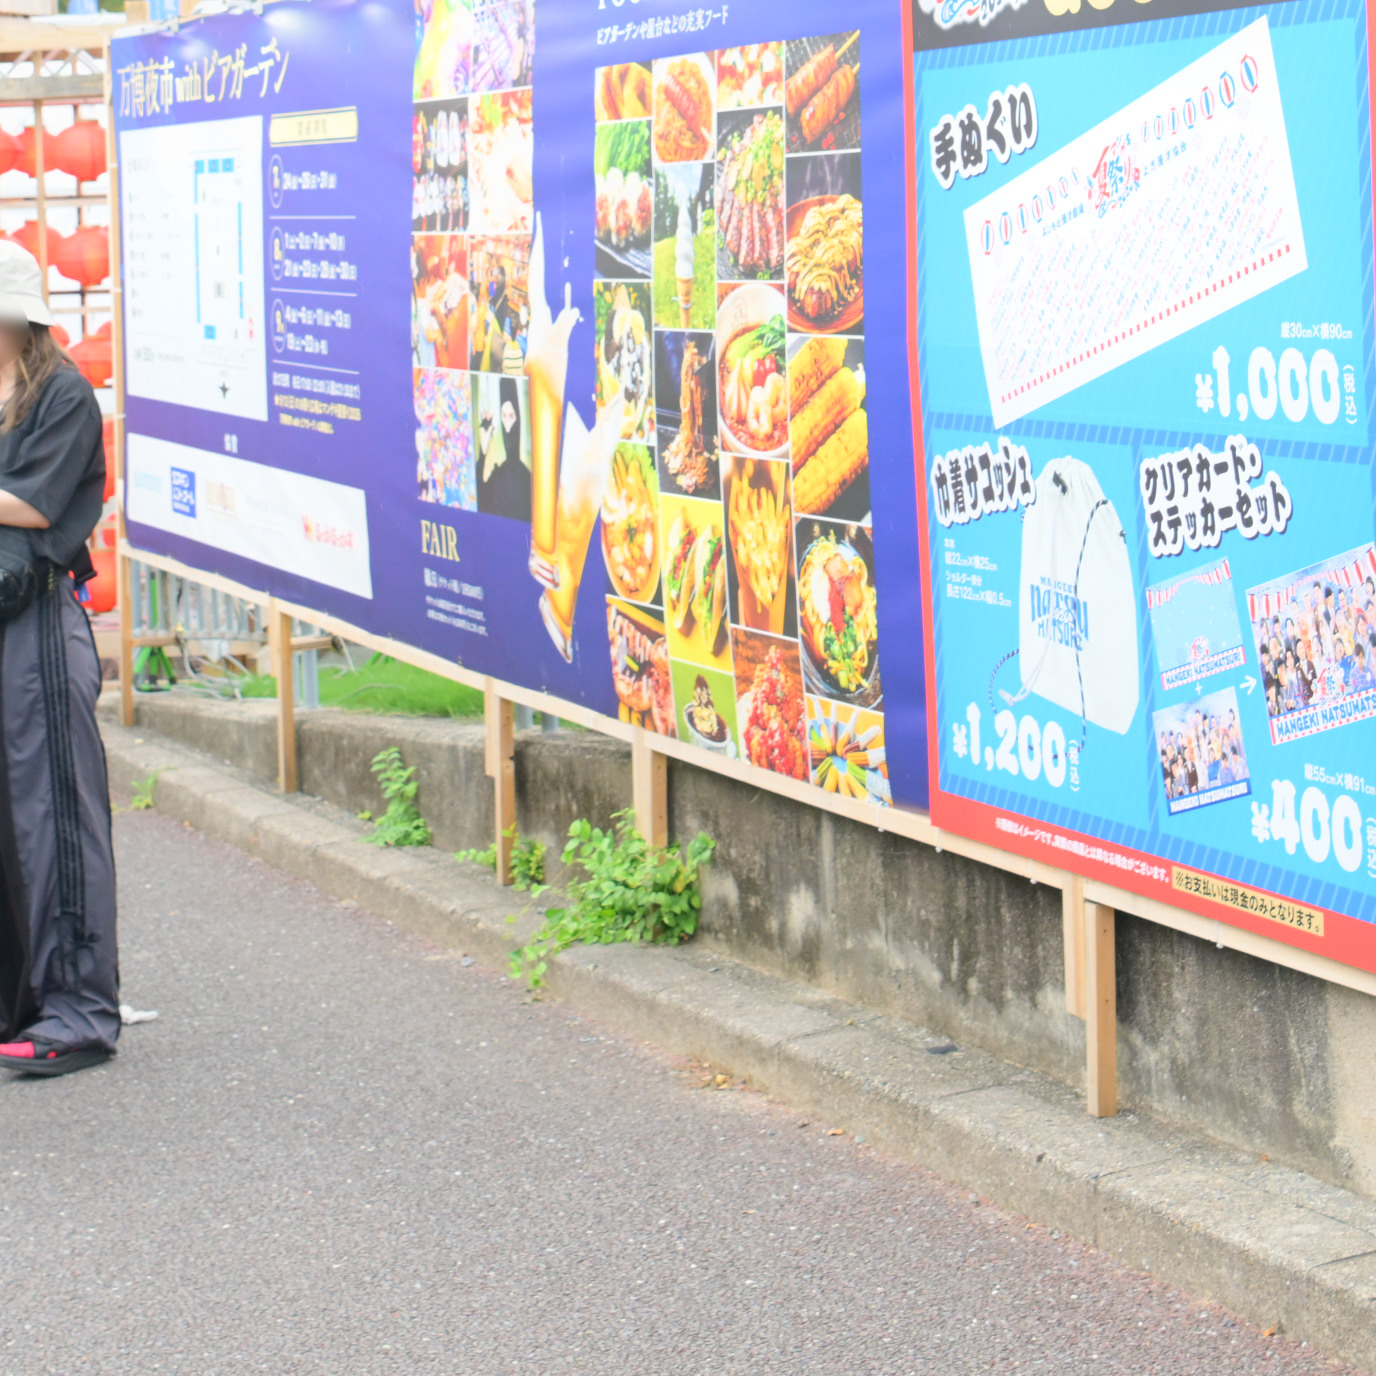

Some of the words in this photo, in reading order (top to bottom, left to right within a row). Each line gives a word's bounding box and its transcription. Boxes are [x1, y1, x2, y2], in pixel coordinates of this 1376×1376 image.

[933, 90, 1035, 181] 手ぬぐい
[1195, 345, 1341, 425] ¥1,000
[934, 445, 1035, 517] 巾着サコッシュ
[1150, 480, 1290, 548] ステッカーセット
[420, 519, 461, 562] FAIR
[952, 701, 1067, 788] ¥1,200
[1251, 778, 1363, 873] ¥400
